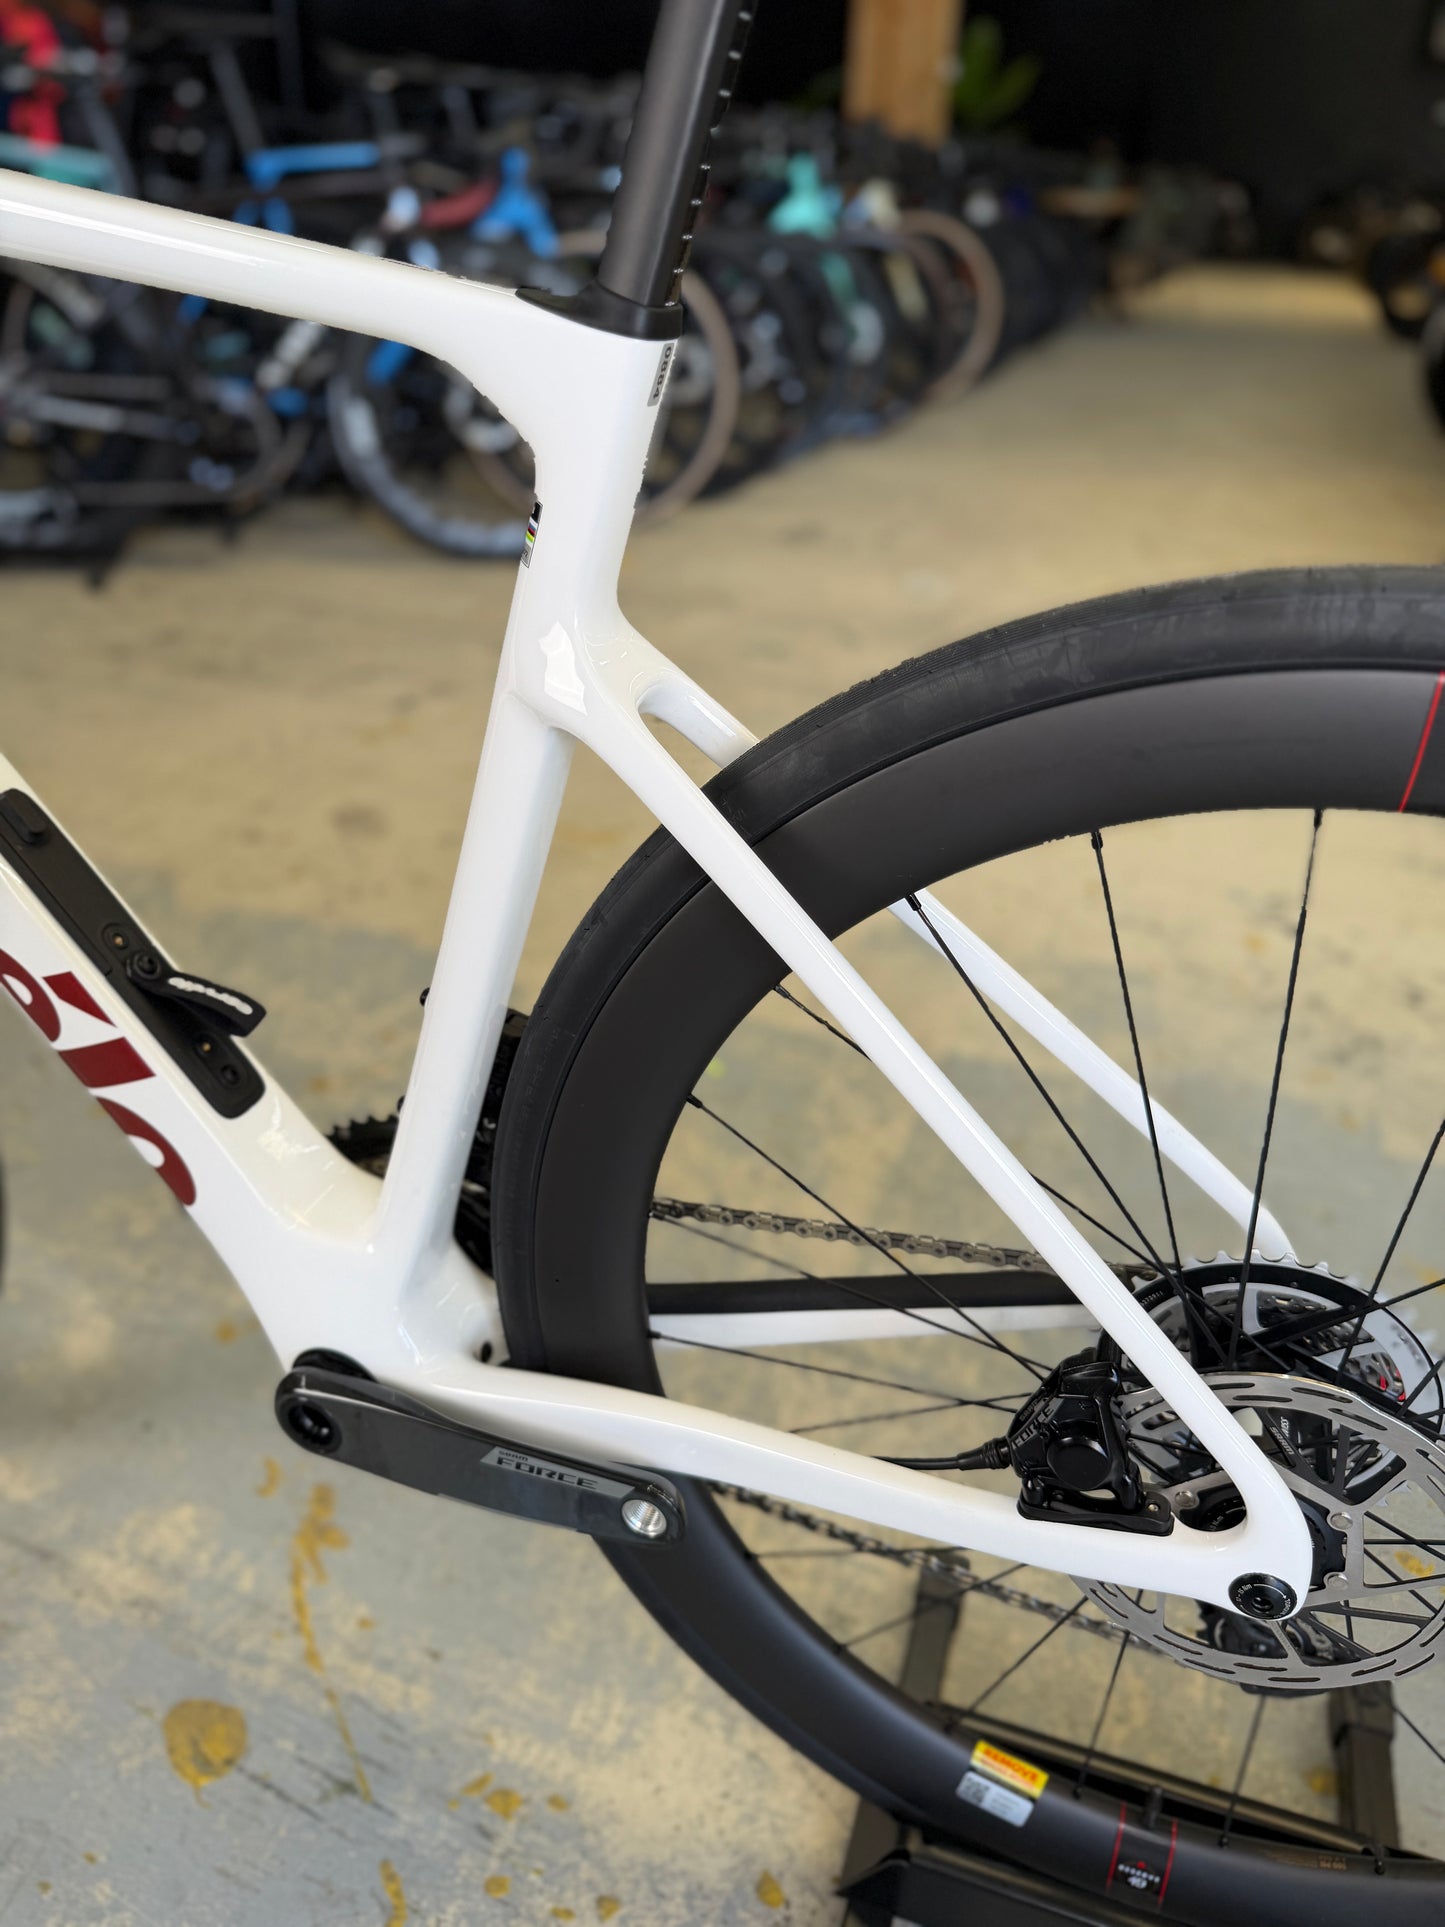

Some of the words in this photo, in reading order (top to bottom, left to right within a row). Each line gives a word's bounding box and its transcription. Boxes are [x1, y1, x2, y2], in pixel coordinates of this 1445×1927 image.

[1269, 1426, 1295, 1456] SRAM
[496, 1456, 599, 1490] FORCE
[983, 1746, 1039, 1782] REMOVE
